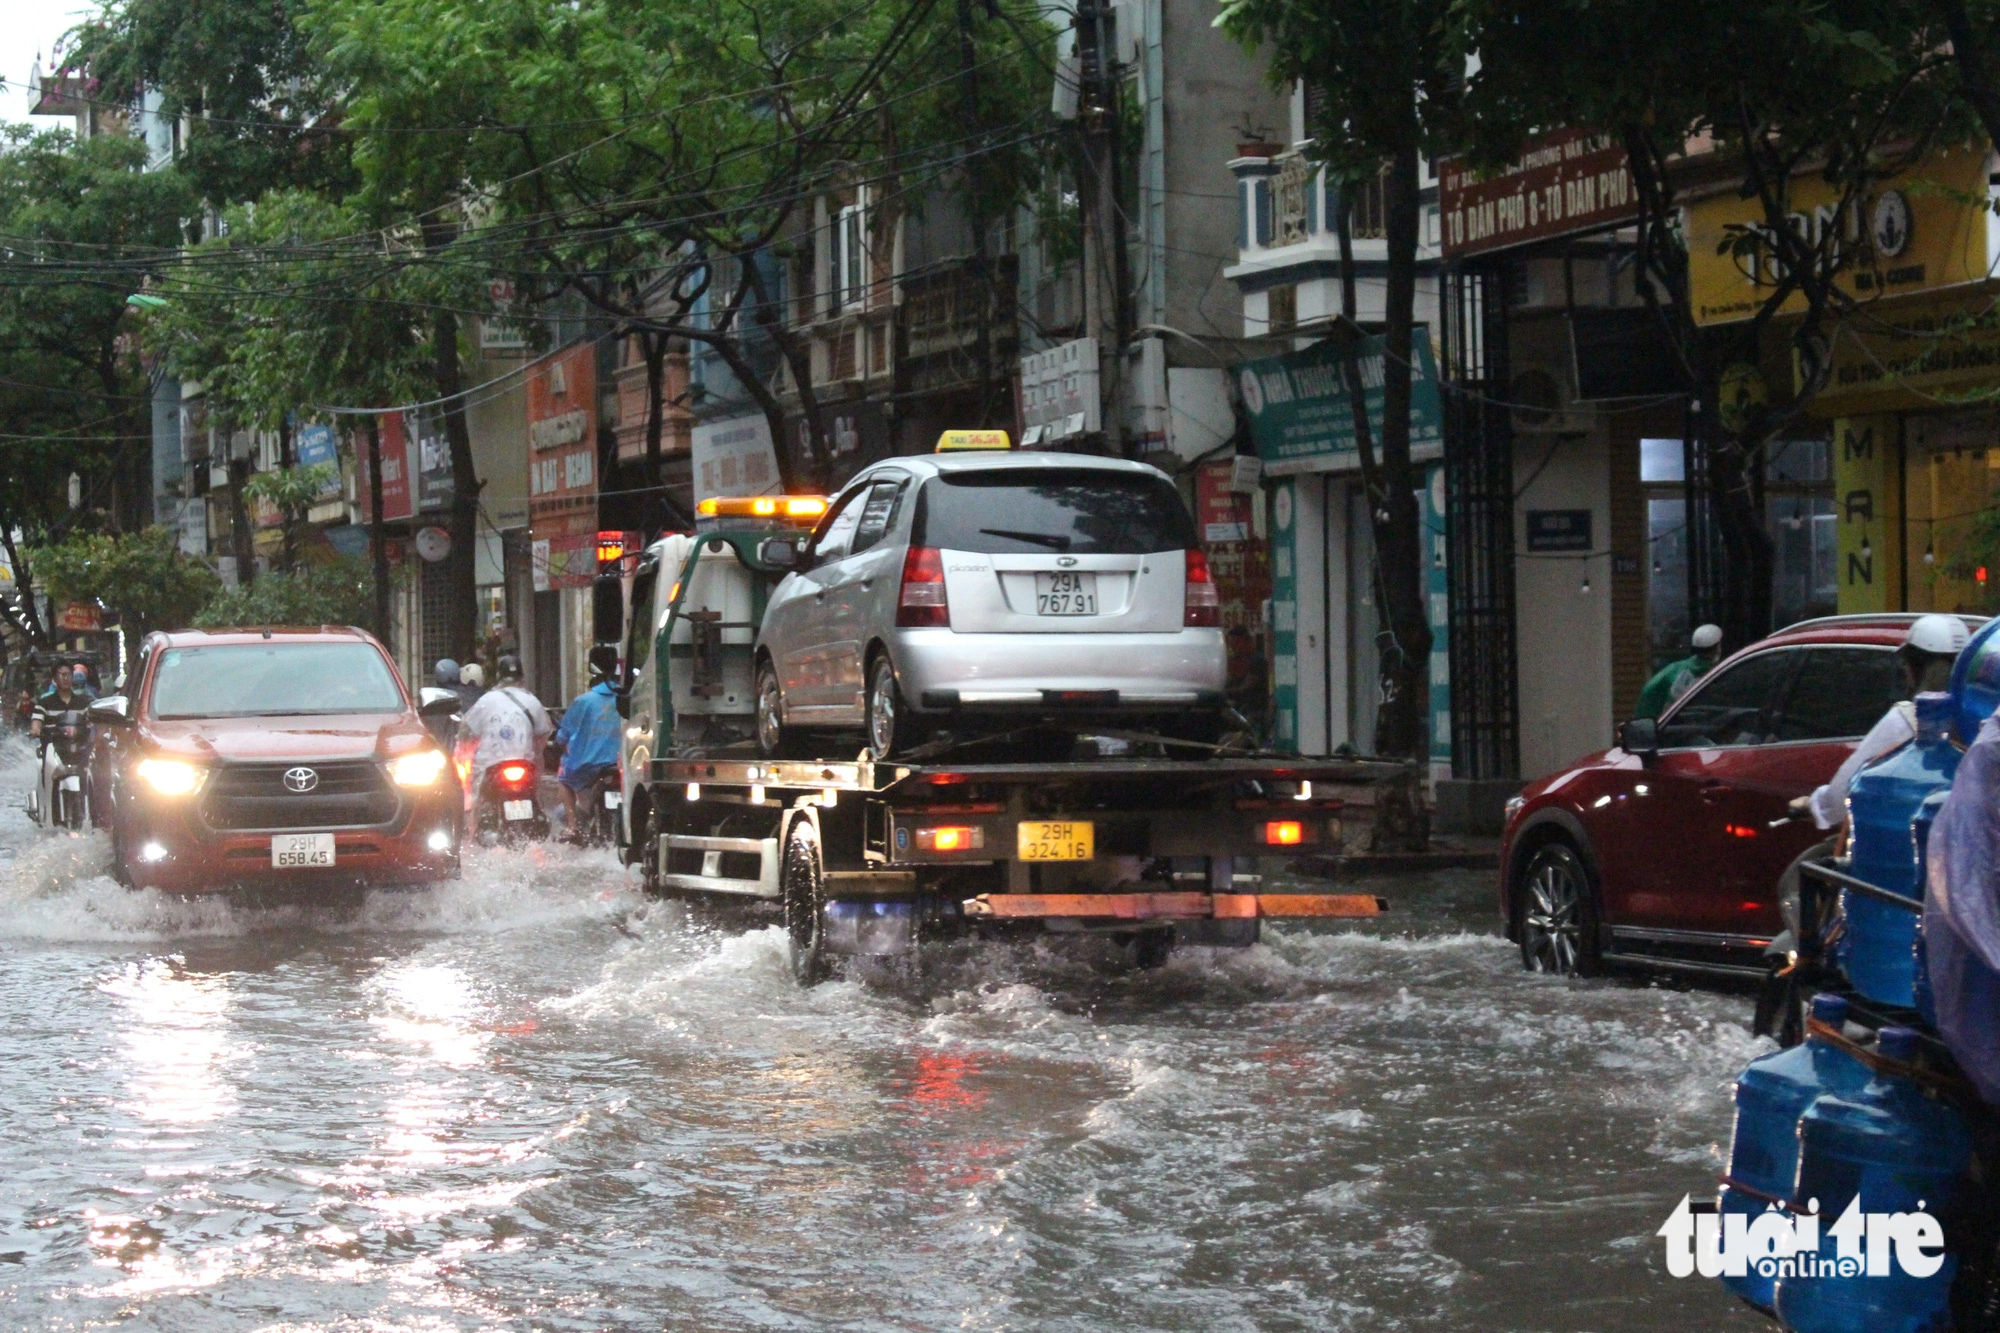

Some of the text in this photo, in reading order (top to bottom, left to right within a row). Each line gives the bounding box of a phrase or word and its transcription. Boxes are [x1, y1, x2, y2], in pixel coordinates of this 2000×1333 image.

[1447, 191, 1464, 246] TỔ
[1468, 195, 1495, 242] DÂN
[1498, 179, 1526, 233] PHỐ
[1566, 170, 1595, 218] DÂN
[1599, 153, 1628, 210] PHỐ
[950, 436, 967, 445] TAXI
[1844, 428, 1874, 587] MAN
[1049, 573, 1082, 593] 29A
[1039, 594, 1094, 613] 767.91
[1041, 824, 1073, 840] 29H
[289, 837, 316, 850] 29H
[1028, 842, 1085, 858] 324.16
[279, 851, 327, 865] 658.45
